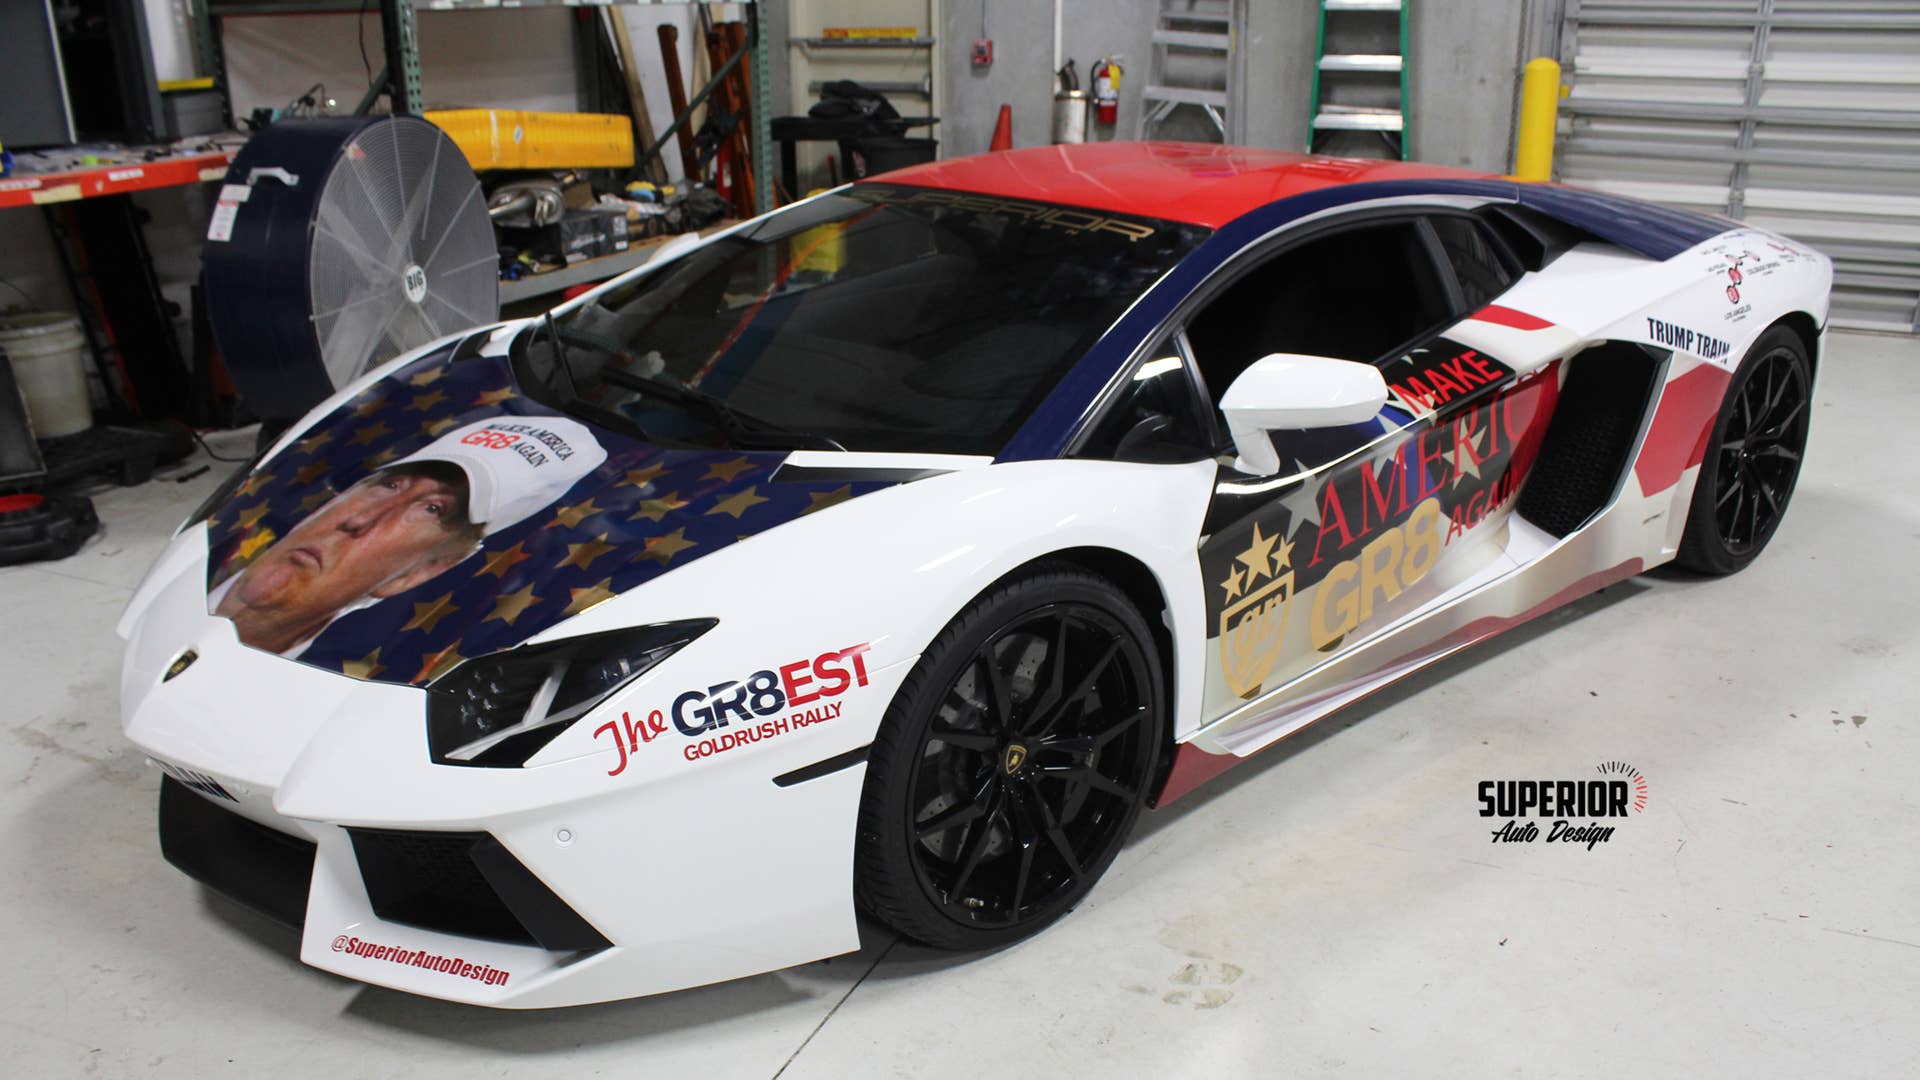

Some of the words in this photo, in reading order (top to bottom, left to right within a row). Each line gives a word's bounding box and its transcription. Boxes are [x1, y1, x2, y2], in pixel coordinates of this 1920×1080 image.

[407, 270, 424, 290] BIG
[1647, 316, 1694, 351] TRUMP
[1697, 333, 1730, 365] TRAIN
[1389, 350, 1504, 415] MAKE
[461, 429, 520, 450] GR8
[509, 441, 549, 468] AGAIN
[527, 427, 575, 462] AMERICA
[1307, 369, 1543, 569] AMERIC
[1310, 497, 1440, 652] GR8
[593, 709, 668, 776] The
[671, 642, 871, 737] GR8EST
[684, 717, 789, 761] GOLDRUSH
[792, 701, 842, 730] RALLY
[331, 935, 510, 986] @SuperiorAutoDesign
